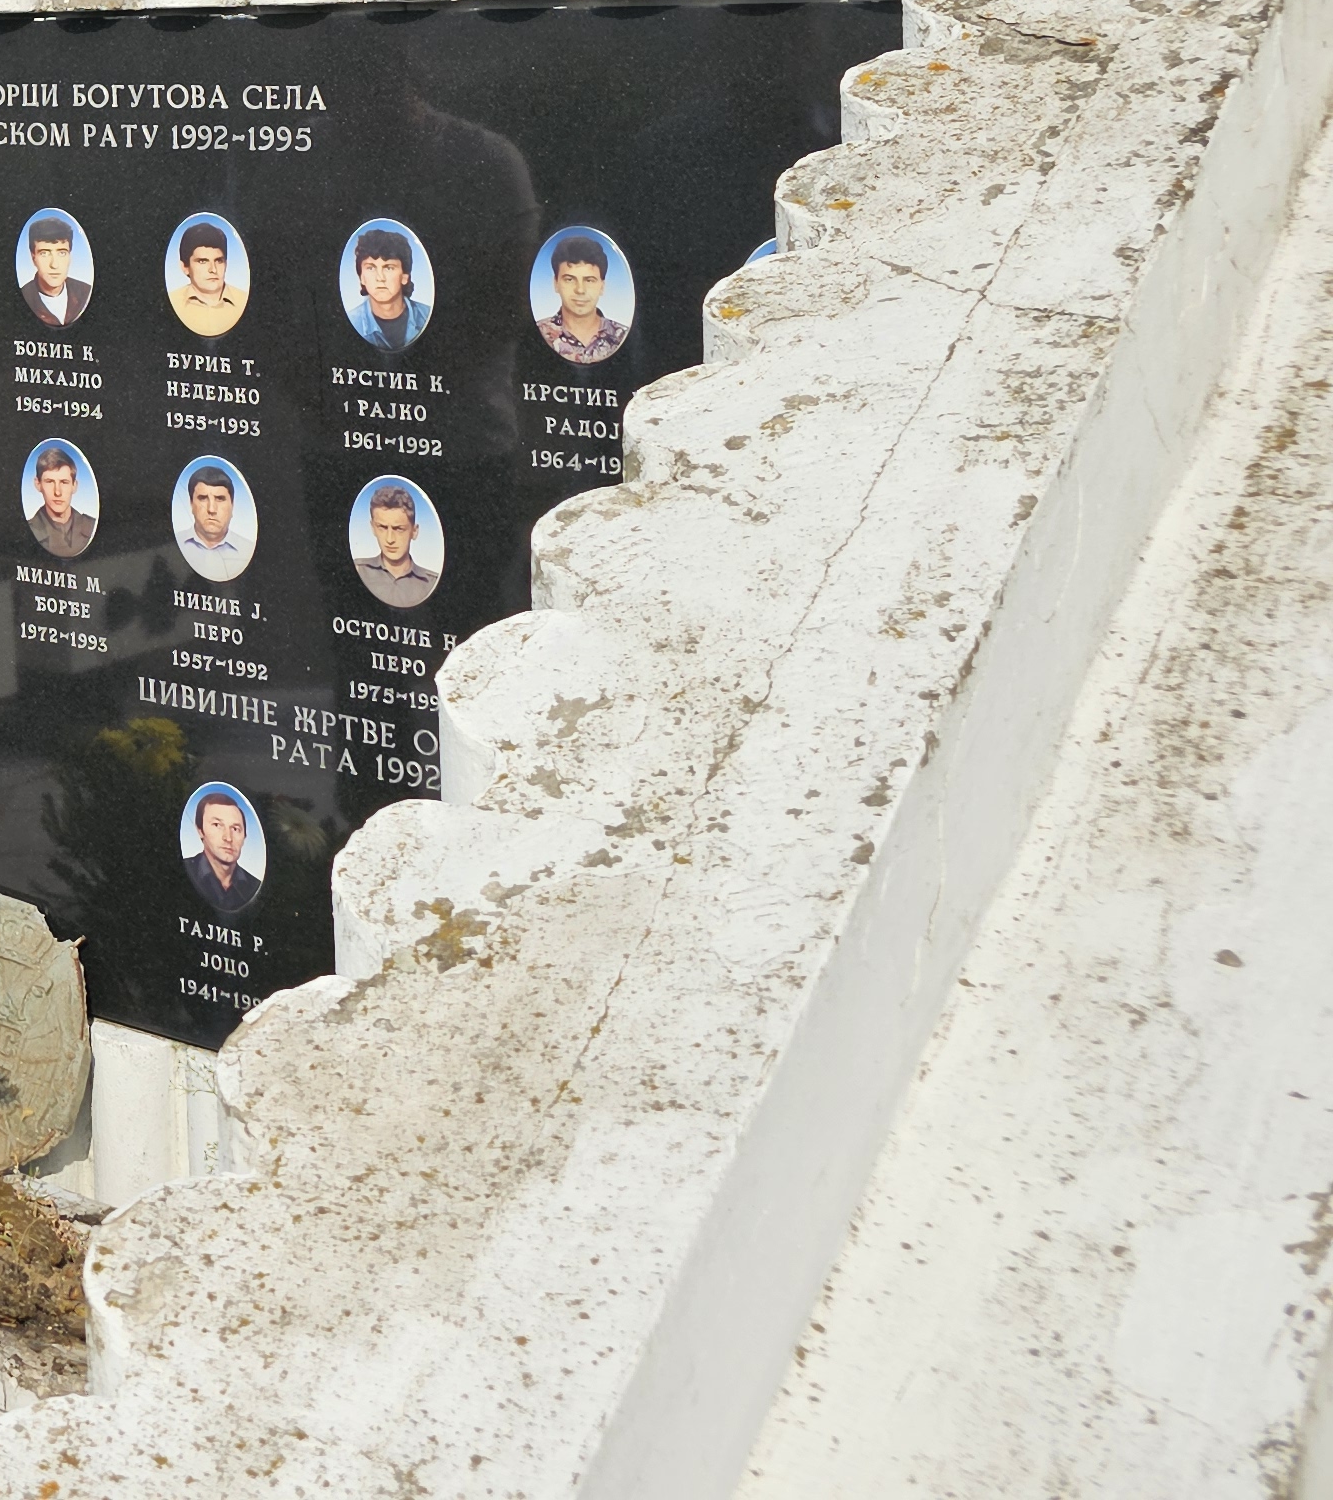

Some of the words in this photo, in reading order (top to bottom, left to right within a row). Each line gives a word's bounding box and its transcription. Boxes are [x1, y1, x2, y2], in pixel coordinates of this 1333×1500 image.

[72, 84, 228, 110] БОГУТОВА
[242, 84, 327, 111] СЕЛА
[84, 125, 158, 149] РАТУ
[83, 345, 100, 363] К.
[14, 366, 102, 389] МИХАЈЛО
[242, 360, 261, 378] Т.
[332, 367, 418, 391] КРСТИЋ
[430, 375, 451, 394] К.
[166, 381, 260, 405] НЕДЕЉКО
[522, 383, 618, 408] КРСТИЋ
[358, 400, 427, 422] РАЈКО
[545, 416, 619, 439] РАДОЈ
[530, 449, 621, 475] 1964-19
[16, 565, 78, 590] МИЈИЋ
[86, 576, 107, 596] М.
[173, 590, 241, 617] НИКИЋ
[251, 603, 268, 622] Ј.
[194, 622, 243, 645] ПЕРО
[333, 616, 432, 648] ОСТОЈИЋ
[371, 652, 426, 677] ПЕРО
[349, 680, 439, 712] 1975-199
[138, 676, 278, 726] ЦИВИЛНЕ
[294, 705, 396, 749] ЖРТВЕ
[271, 734, 358, 776] РАТА
[375, 754, 441, 791] 1992
[179, 916, 242, 947] ГАЈИЋ
[253, 936, 268, 955] Р.
[201, 952, 249, 978] ЈОЦО
